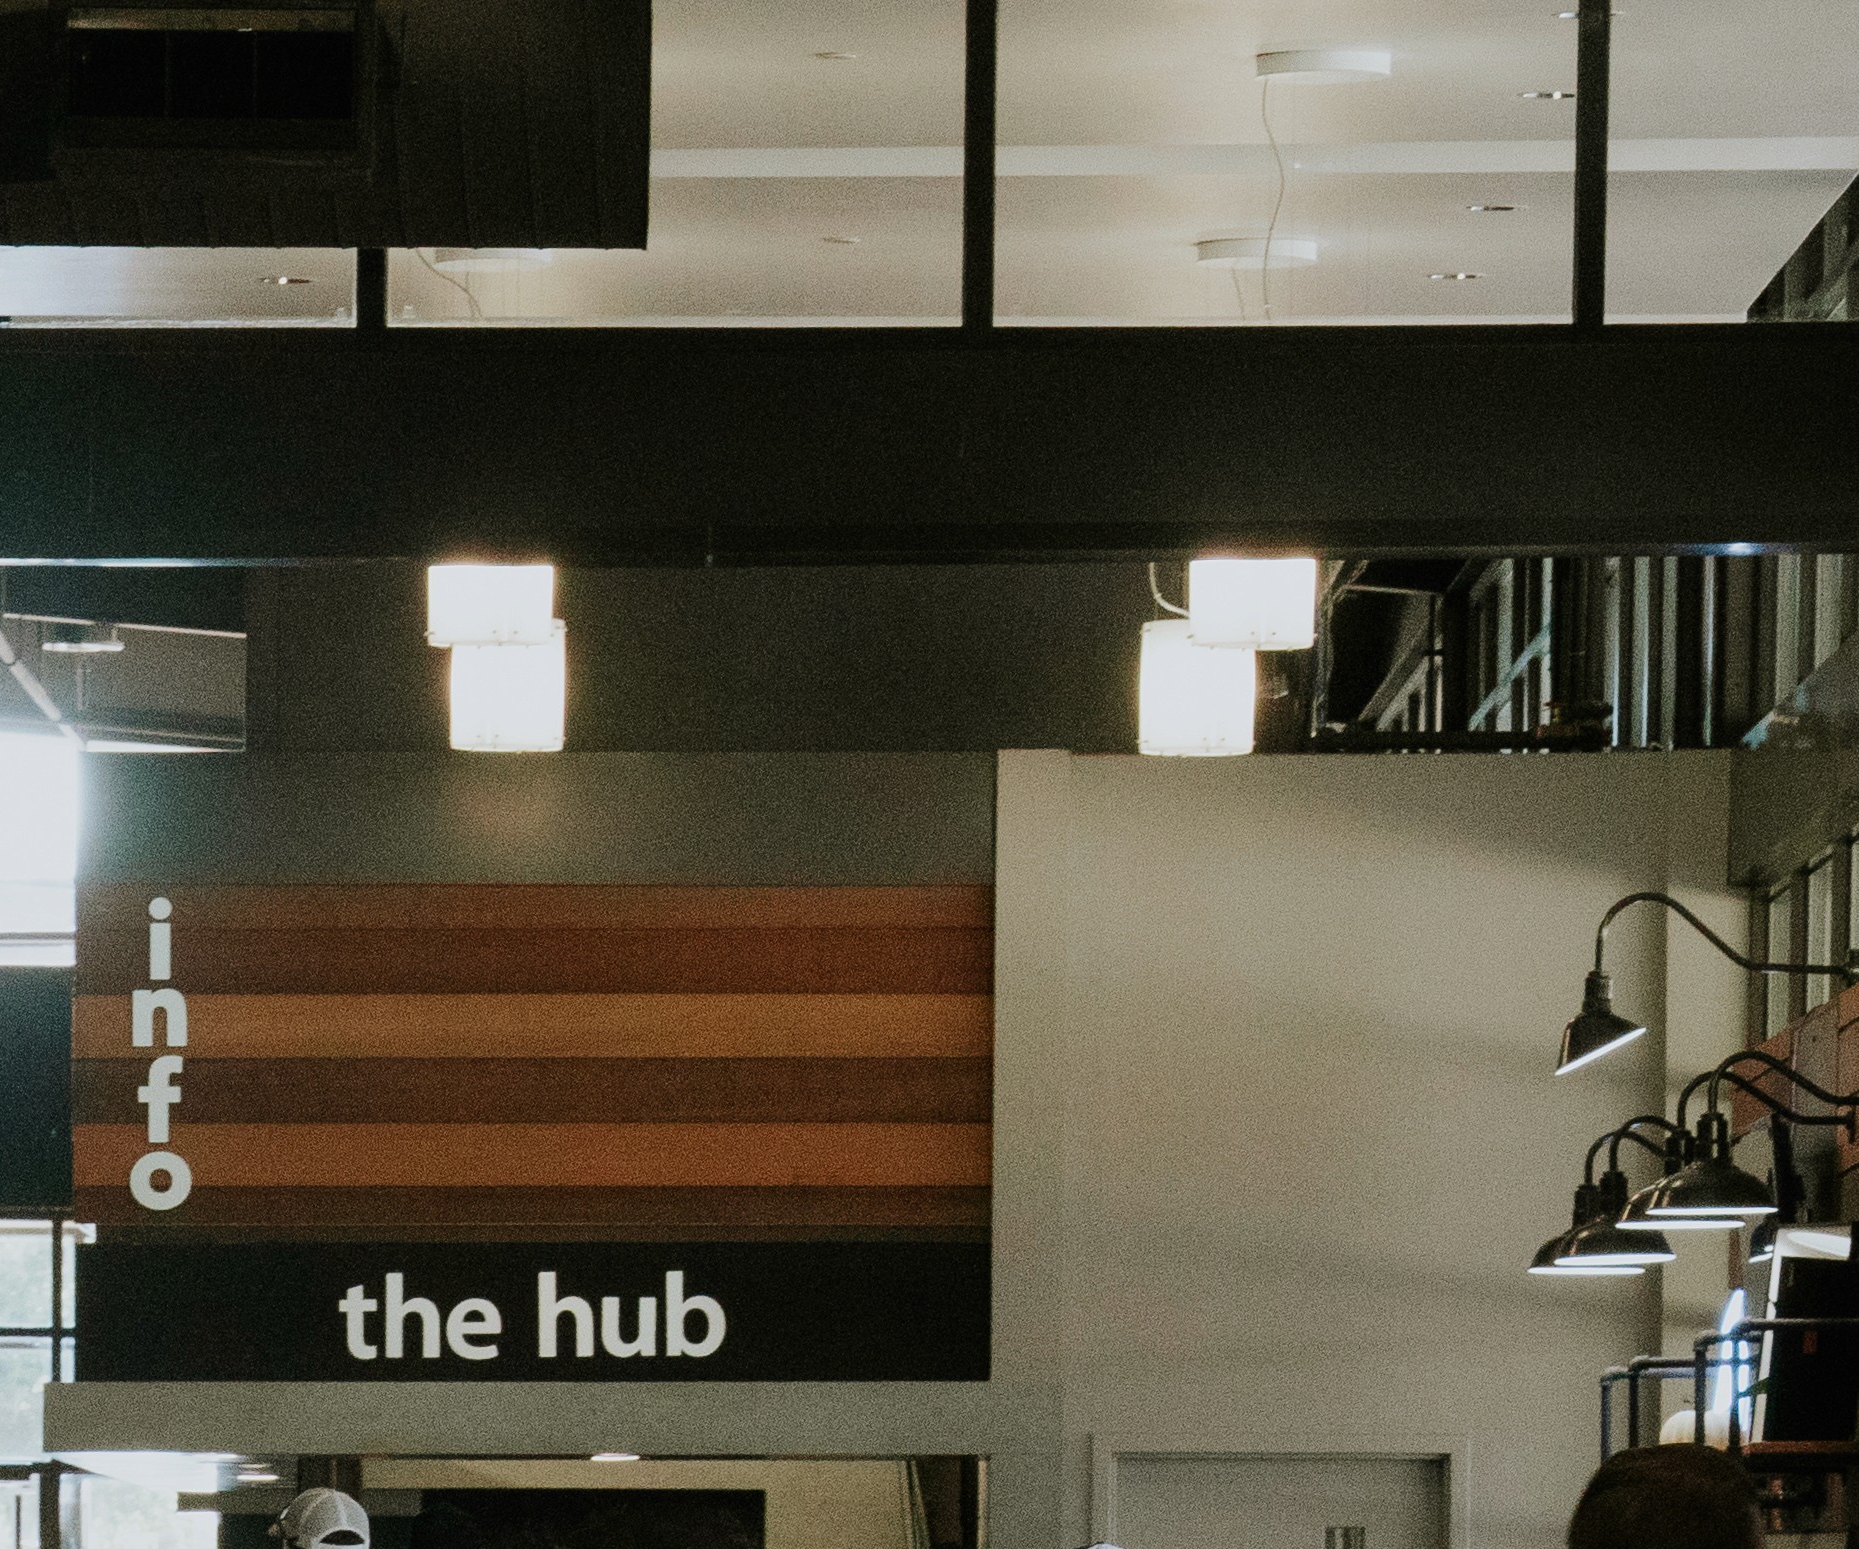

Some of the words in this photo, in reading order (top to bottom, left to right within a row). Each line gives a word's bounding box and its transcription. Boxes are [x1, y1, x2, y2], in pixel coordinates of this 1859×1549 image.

[129, 897, 192, 1211] info
[339, 1272, 502, 1360] the
[538, 1270, 727, 1358] hub
